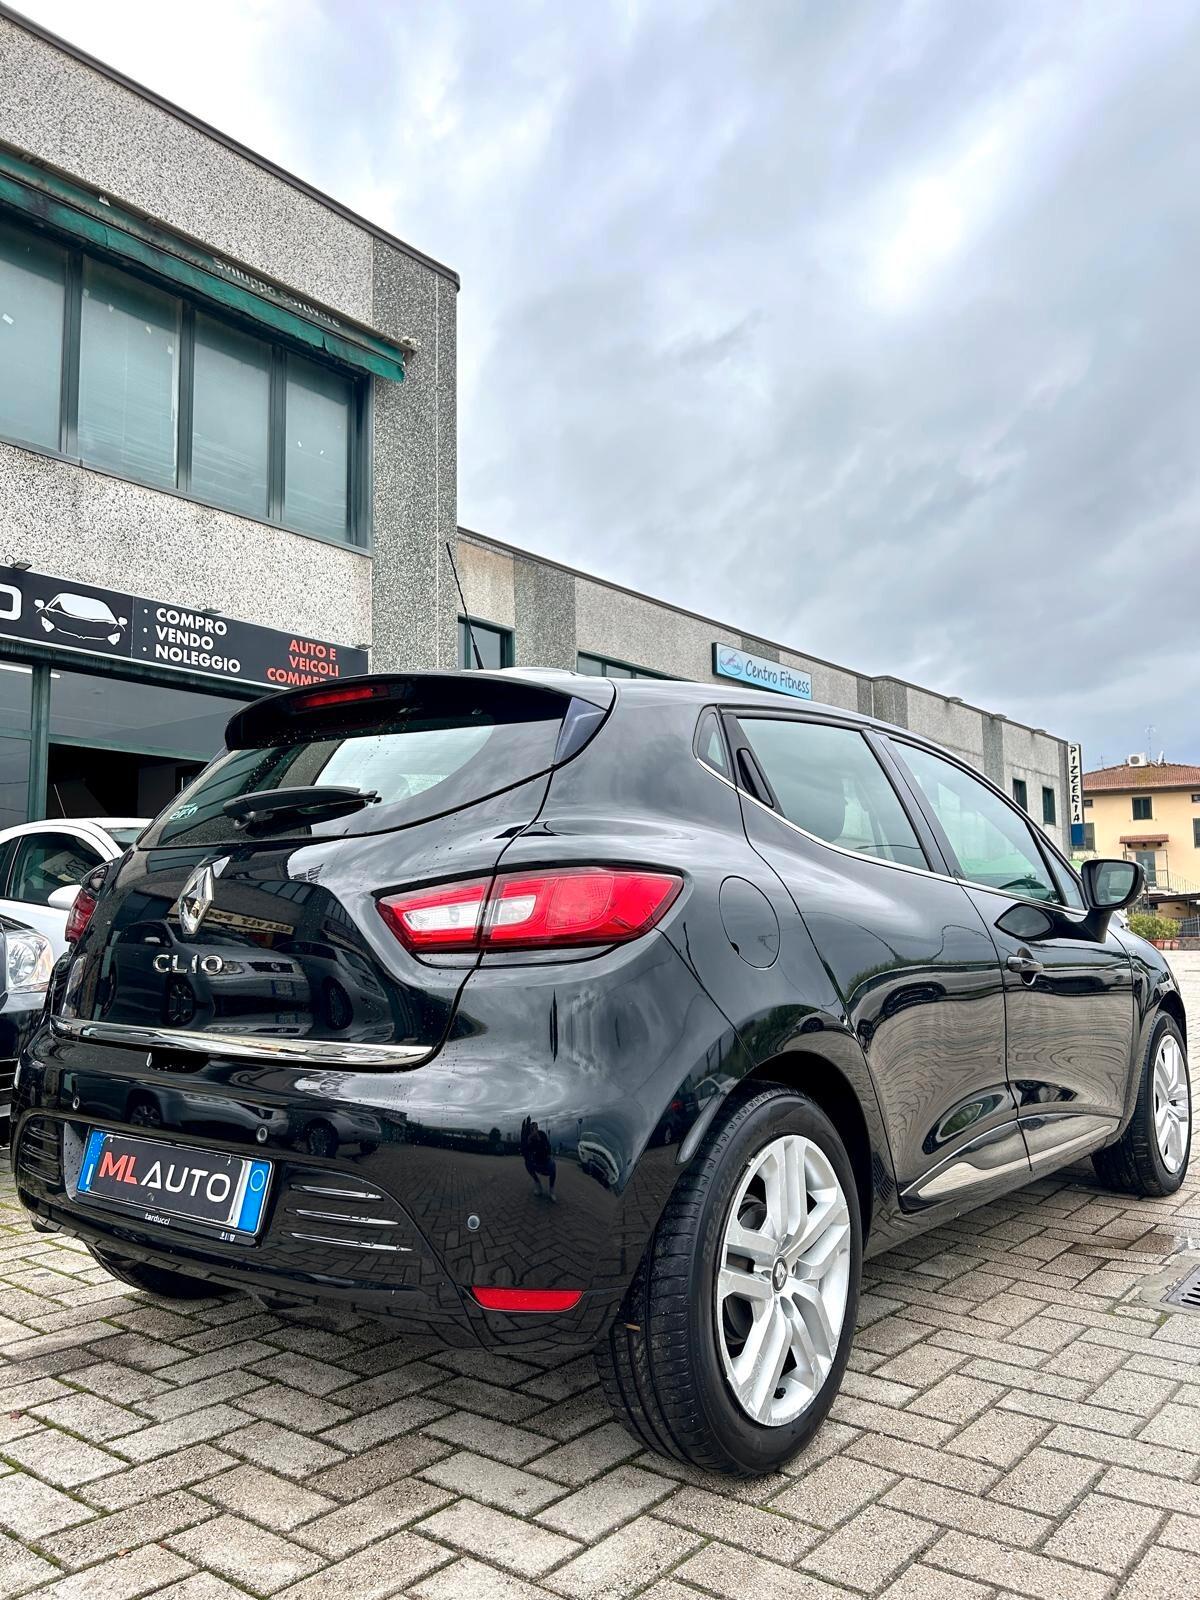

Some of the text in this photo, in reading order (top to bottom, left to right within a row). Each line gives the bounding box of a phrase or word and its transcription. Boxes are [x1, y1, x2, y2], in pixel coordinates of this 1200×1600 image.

[156, 608, 227, 636] COMPRO
[155, 625, 214, 650] VENDO
[289, 639, 336, 660] AUTO E
[155, 643, 241, 673] NOLEGGIO
[289, 654, 338, 677] VEICOLI
[745, 659, 810, 694] Centro Fitness
[1070, 745, 1080, 822] PIZZERIA
[152, 954, 224, 975] CLIO
